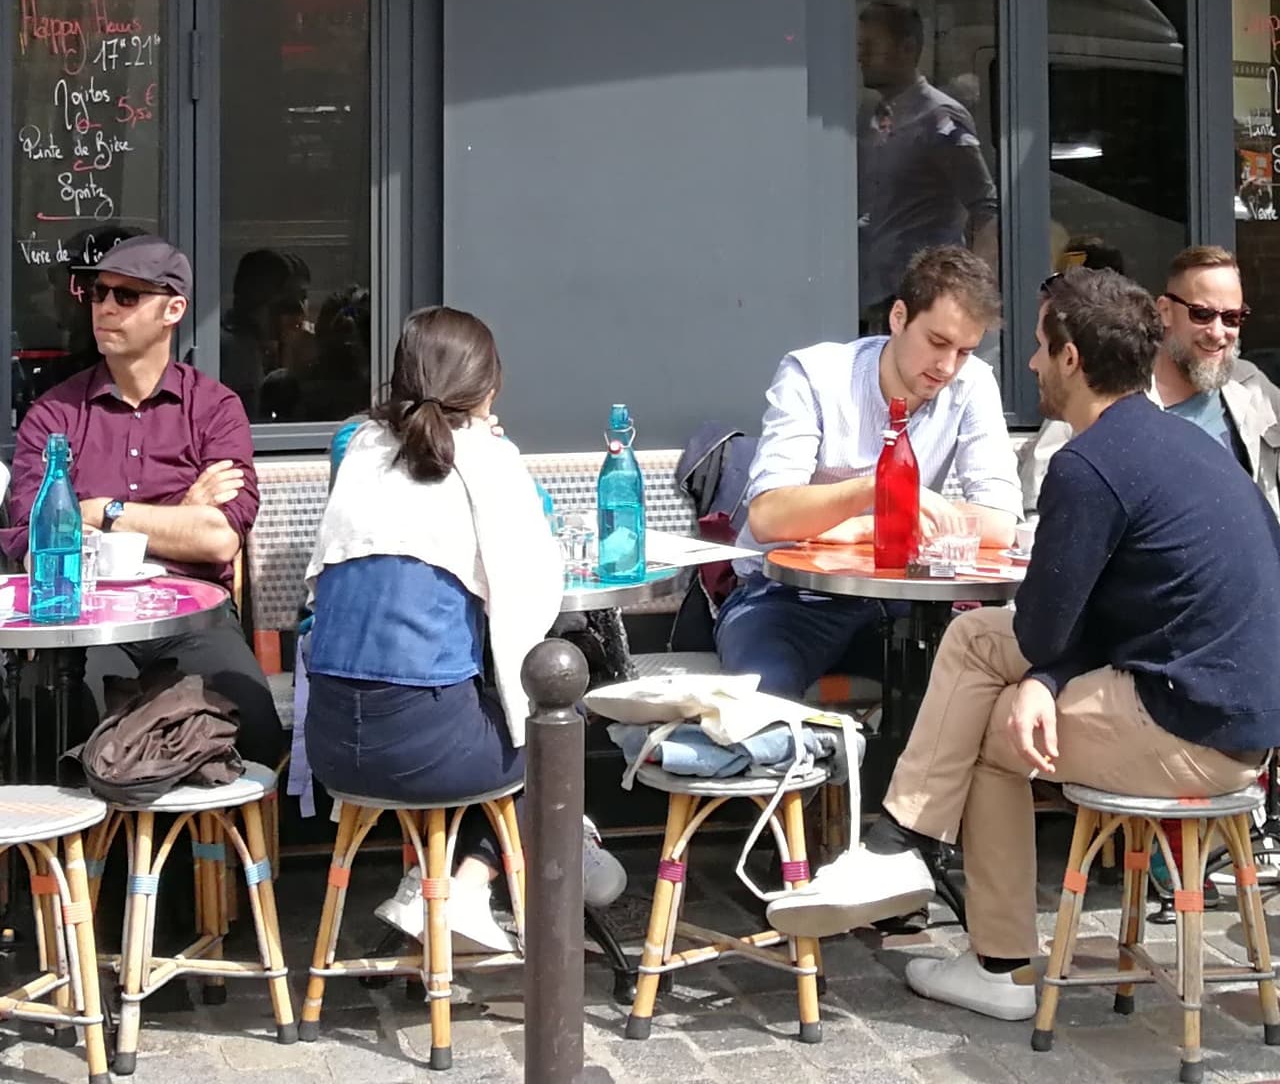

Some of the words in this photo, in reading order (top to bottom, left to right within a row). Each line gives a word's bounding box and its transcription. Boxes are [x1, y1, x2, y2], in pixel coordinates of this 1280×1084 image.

[19, 125, 64, 159] Pinte
[74, 139, 89, 157] de
[95, 131, 135, 170] Bière
[58, 172, 114, 222] Spritz
[17, 230, 51, 265] Verre
[56, 239, 71, 263] de
